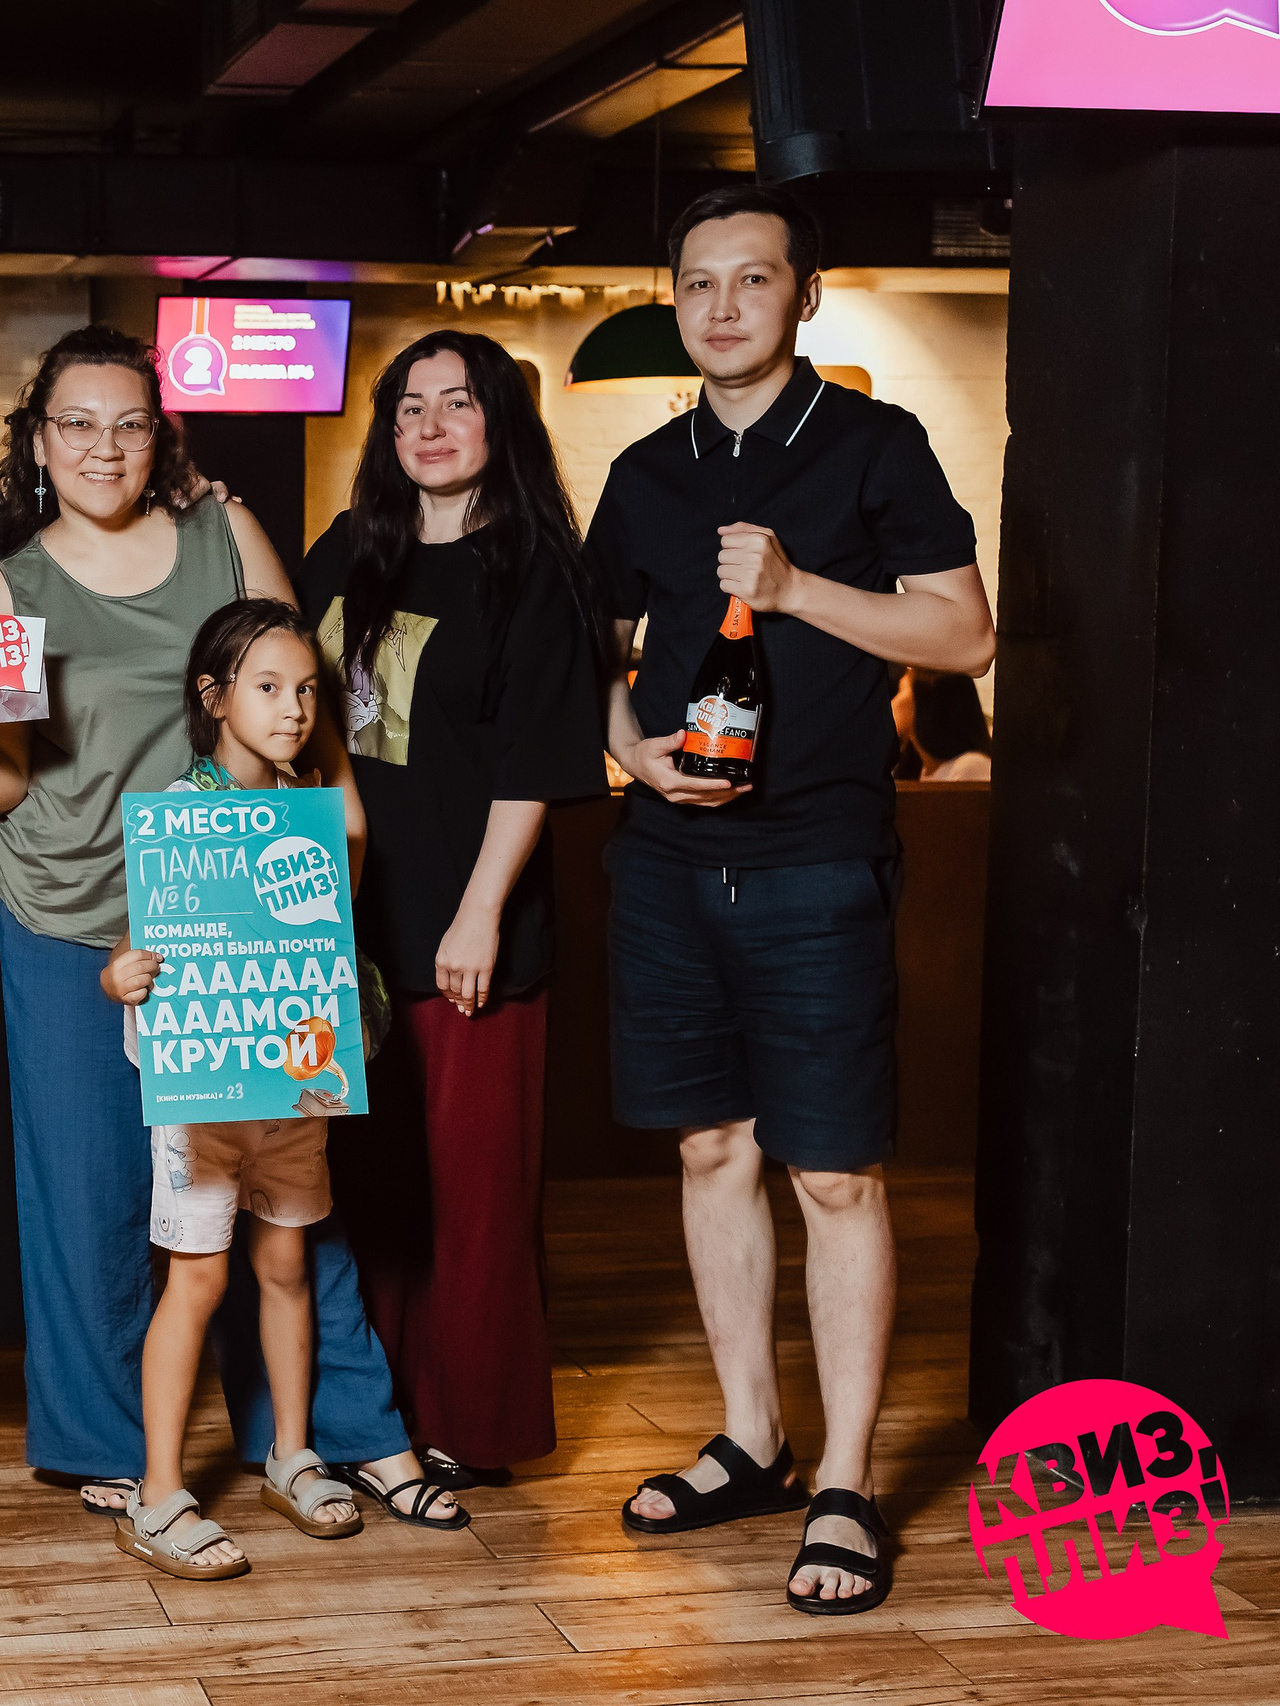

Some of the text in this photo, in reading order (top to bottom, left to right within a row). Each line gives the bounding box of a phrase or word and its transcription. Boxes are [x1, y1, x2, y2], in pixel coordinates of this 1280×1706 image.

[137, 805, 276, 836] 2 МЕСТО
[139, 843, 250, 887] ПАЛАТА
[258, 873, 339, 913] ПЛИЗ!
[143, 922, 233, 940] КОМАНДЕ,
[227, 939, 277, 956] БЫЛА
[279, 937, 336, 954] ПОЧТИ
[151, 1025, 318, 1075] КРУТОЙ
[226, 1082, 244, 1100] 23
